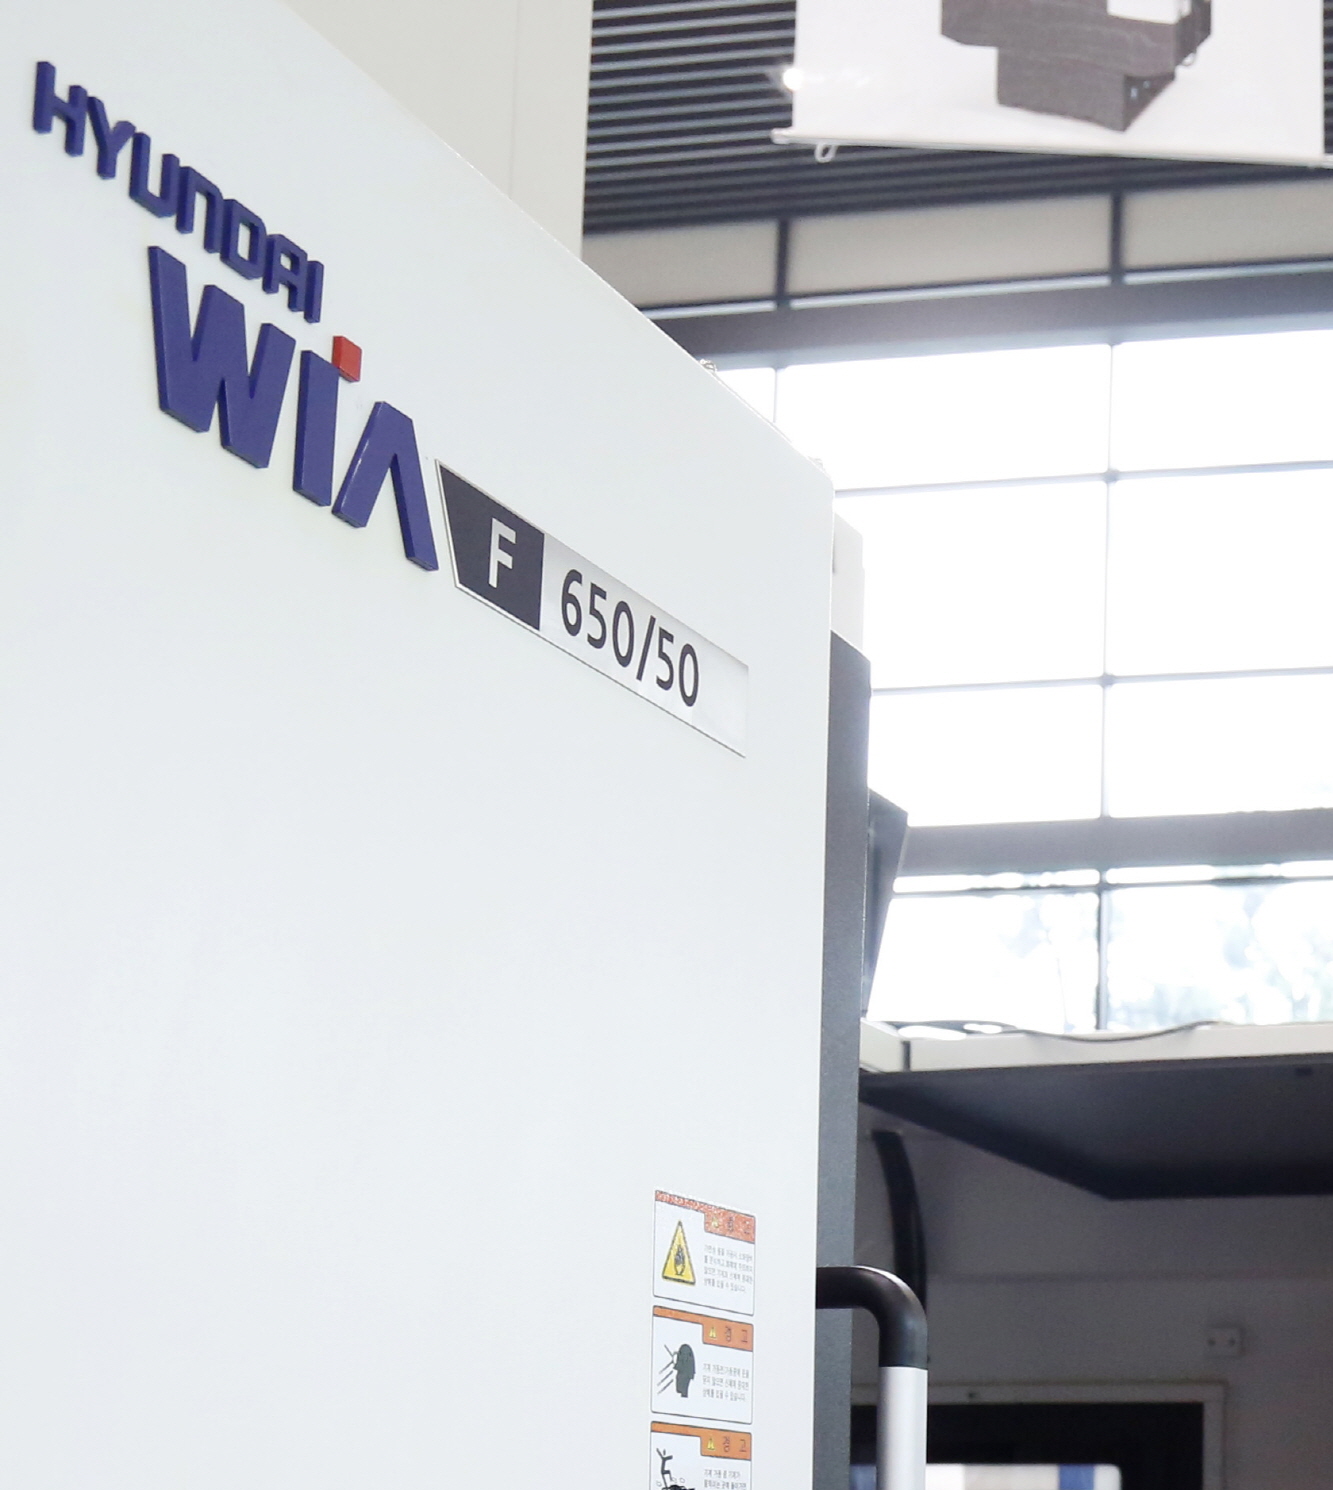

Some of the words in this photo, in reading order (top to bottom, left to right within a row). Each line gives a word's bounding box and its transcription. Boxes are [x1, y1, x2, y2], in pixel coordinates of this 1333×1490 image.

[33, 61, 324, 323] HYUNDAI
[489, 519, 516, 589] F
[561, 569, 701, 709] 650/50
